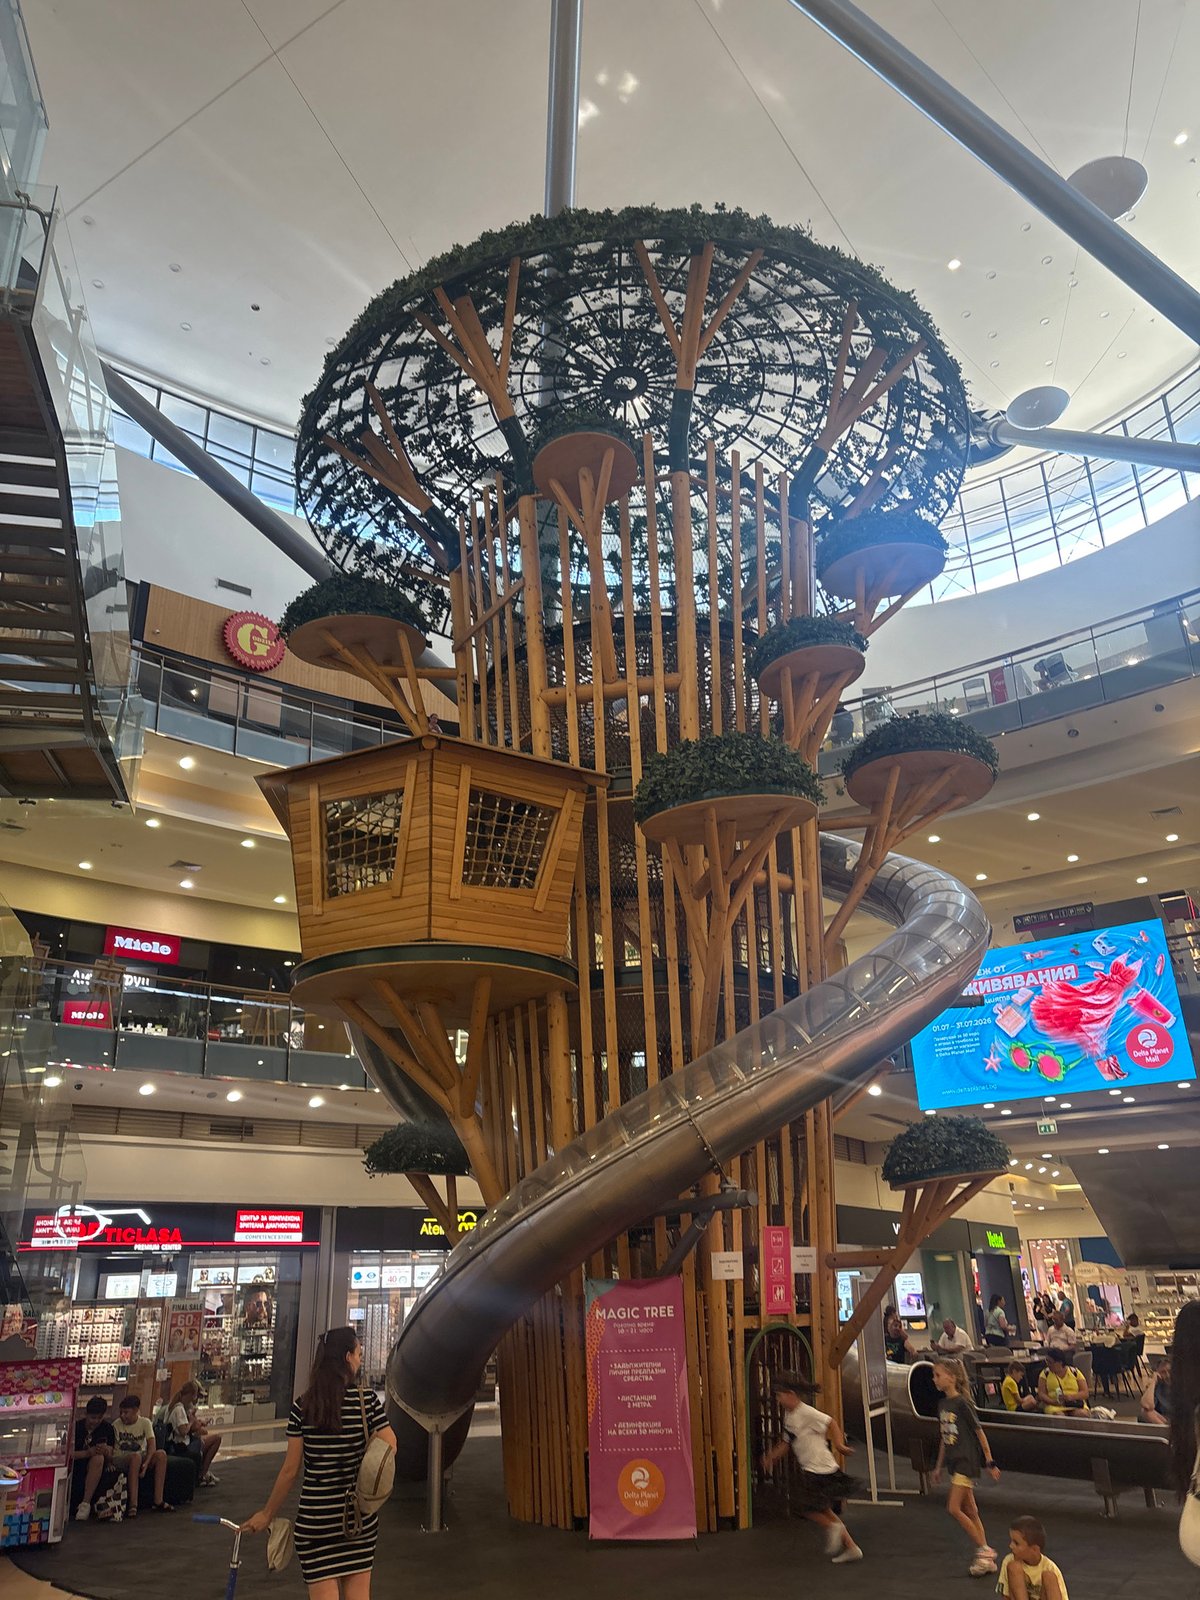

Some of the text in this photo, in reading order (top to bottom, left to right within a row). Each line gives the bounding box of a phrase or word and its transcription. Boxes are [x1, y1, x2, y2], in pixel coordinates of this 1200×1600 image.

[114, 935, 171, 955] Miele
[994, 965, 1006, 973] ОТ
[932, 1024, 950, 1032] 01.07
[956, 1018, 992, 1029] 31.07.2026
[1133, 1047, 1169, 1058] Delta Planet
[1145, 1055, 1160, 1063] Mall
[134, 1243, 160, 1251] PREMIUM
[595, 1305, 675, 1320] MAGIC TREE
[620, 1394, 657, 1402] ДИСТАНЦИЯ
[618, 1421, 662, 1429] ДЕЗИНФЕКЦИЯ
[648, 1427, 673, 1435] МИНУТИ
[623, 1490, 659, 1499] Delta Planet
